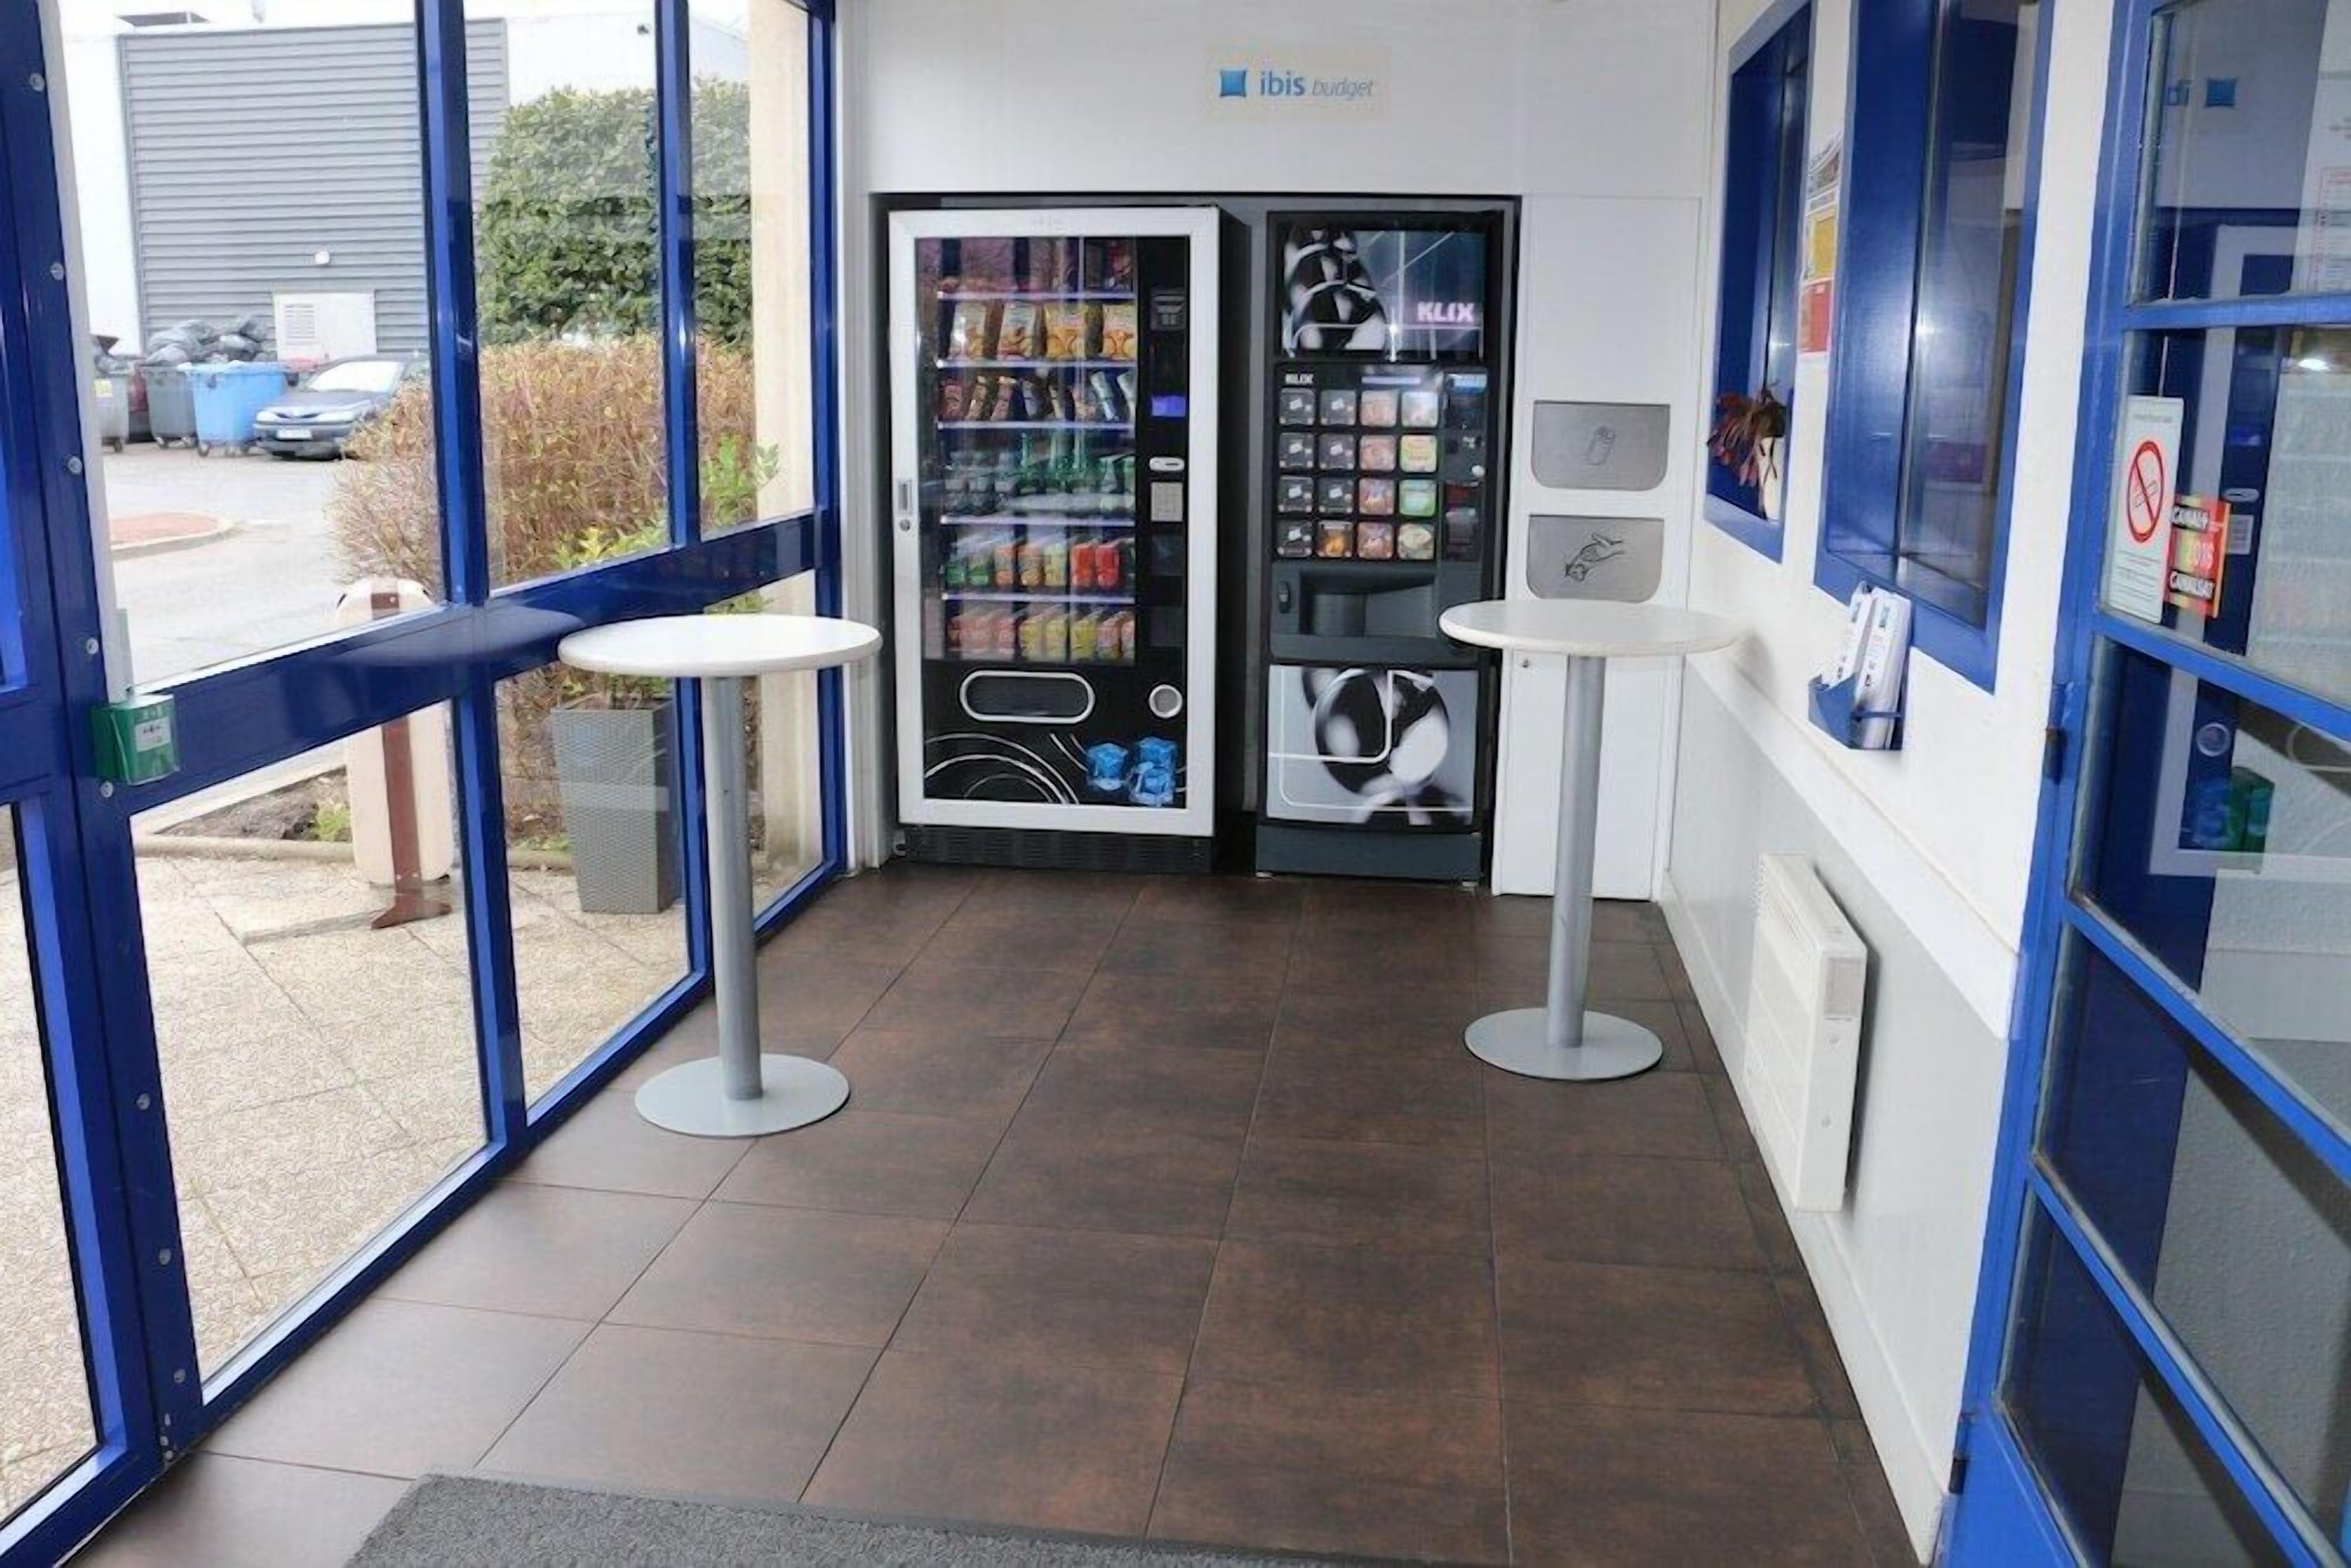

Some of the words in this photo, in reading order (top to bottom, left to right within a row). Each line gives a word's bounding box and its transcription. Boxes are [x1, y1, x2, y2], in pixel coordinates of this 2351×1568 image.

[1260, 70, 1305, 96] ibis
[1312, 78, 1373, 100] budget
[1418, 301, 1474, 321] KLIX
